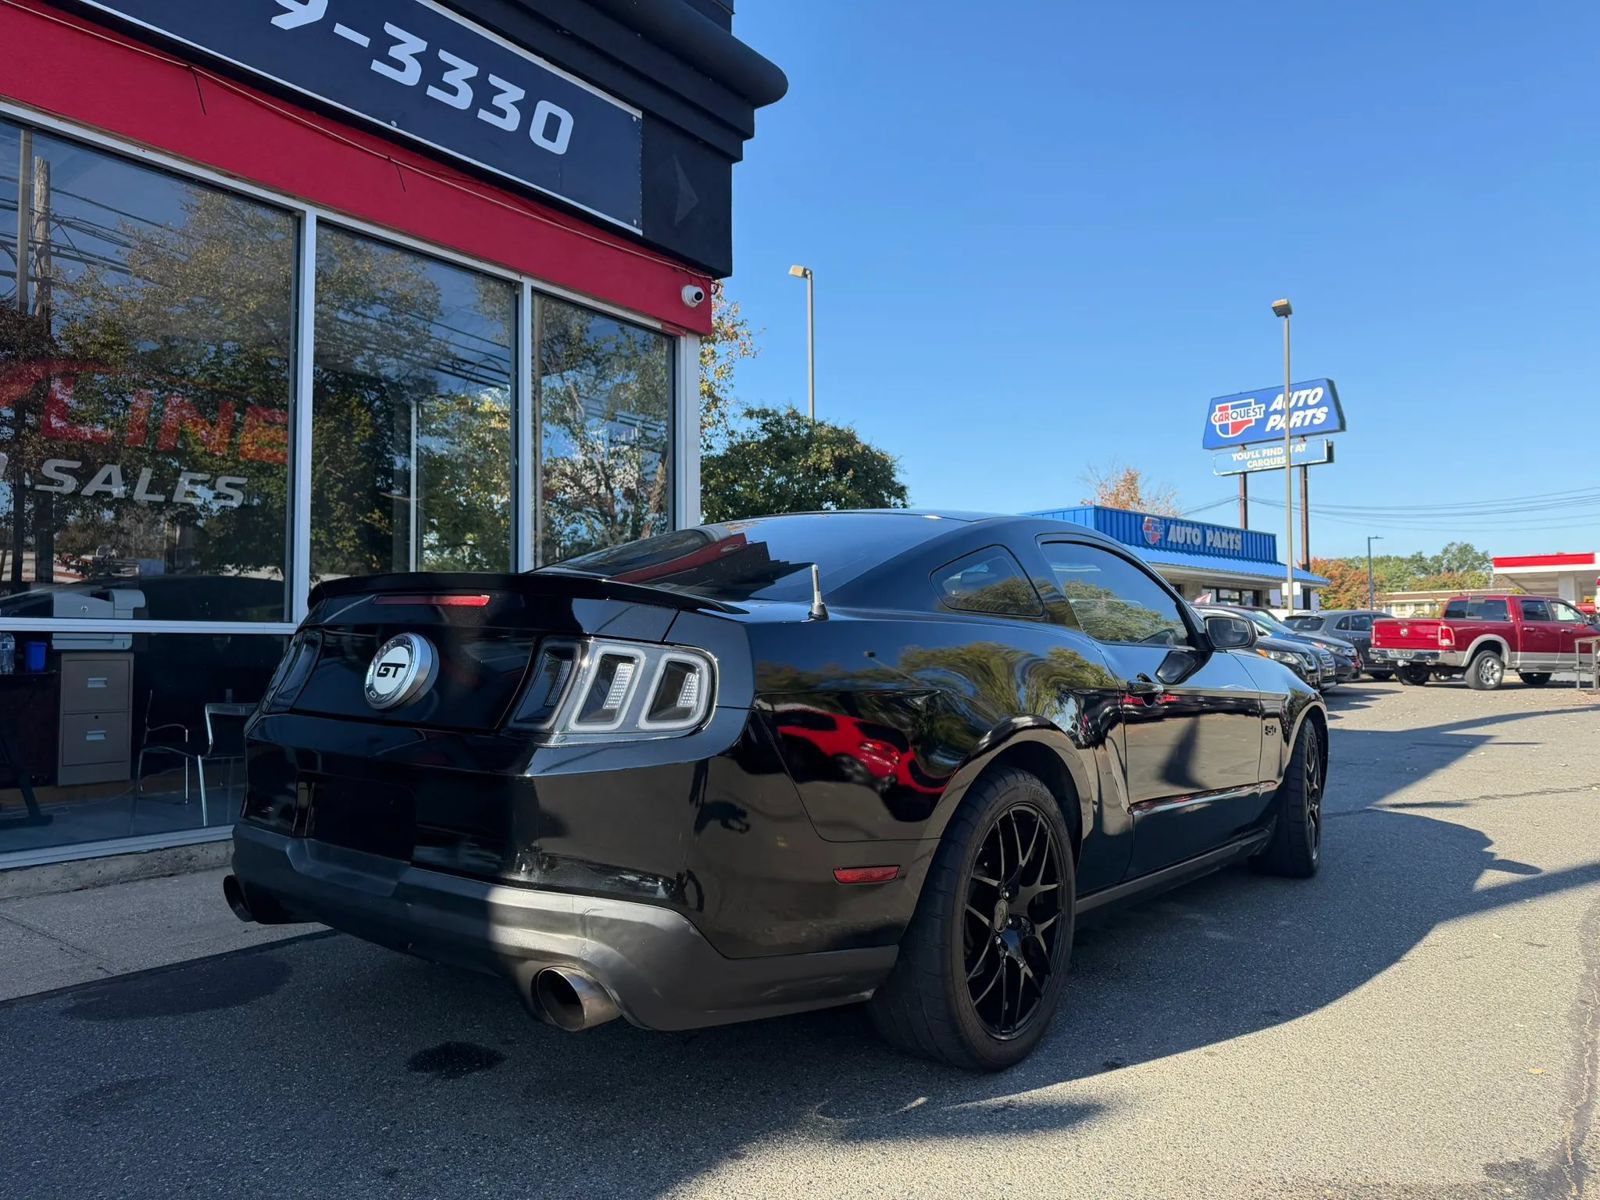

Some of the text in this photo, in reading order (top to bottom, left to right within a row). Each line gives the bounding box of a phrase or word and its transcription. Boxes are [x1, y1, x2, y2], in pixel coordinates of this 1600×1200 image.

[1269, 387, 1324, 411] AUTO
[1213, 406, 1263, 423] CARQUEST
[1265, 406, 1328, 432] PARTS
[1247, 456, 1286, 468] CARQUES
[1262, 447, 1283, 458] FIND
[34, 458, 248, 507] SALES
[1167, 524, 1201, 546] AUTO
[1205, 528, 1242, 551] PARTS
[376, 662, 406, 678] GT
